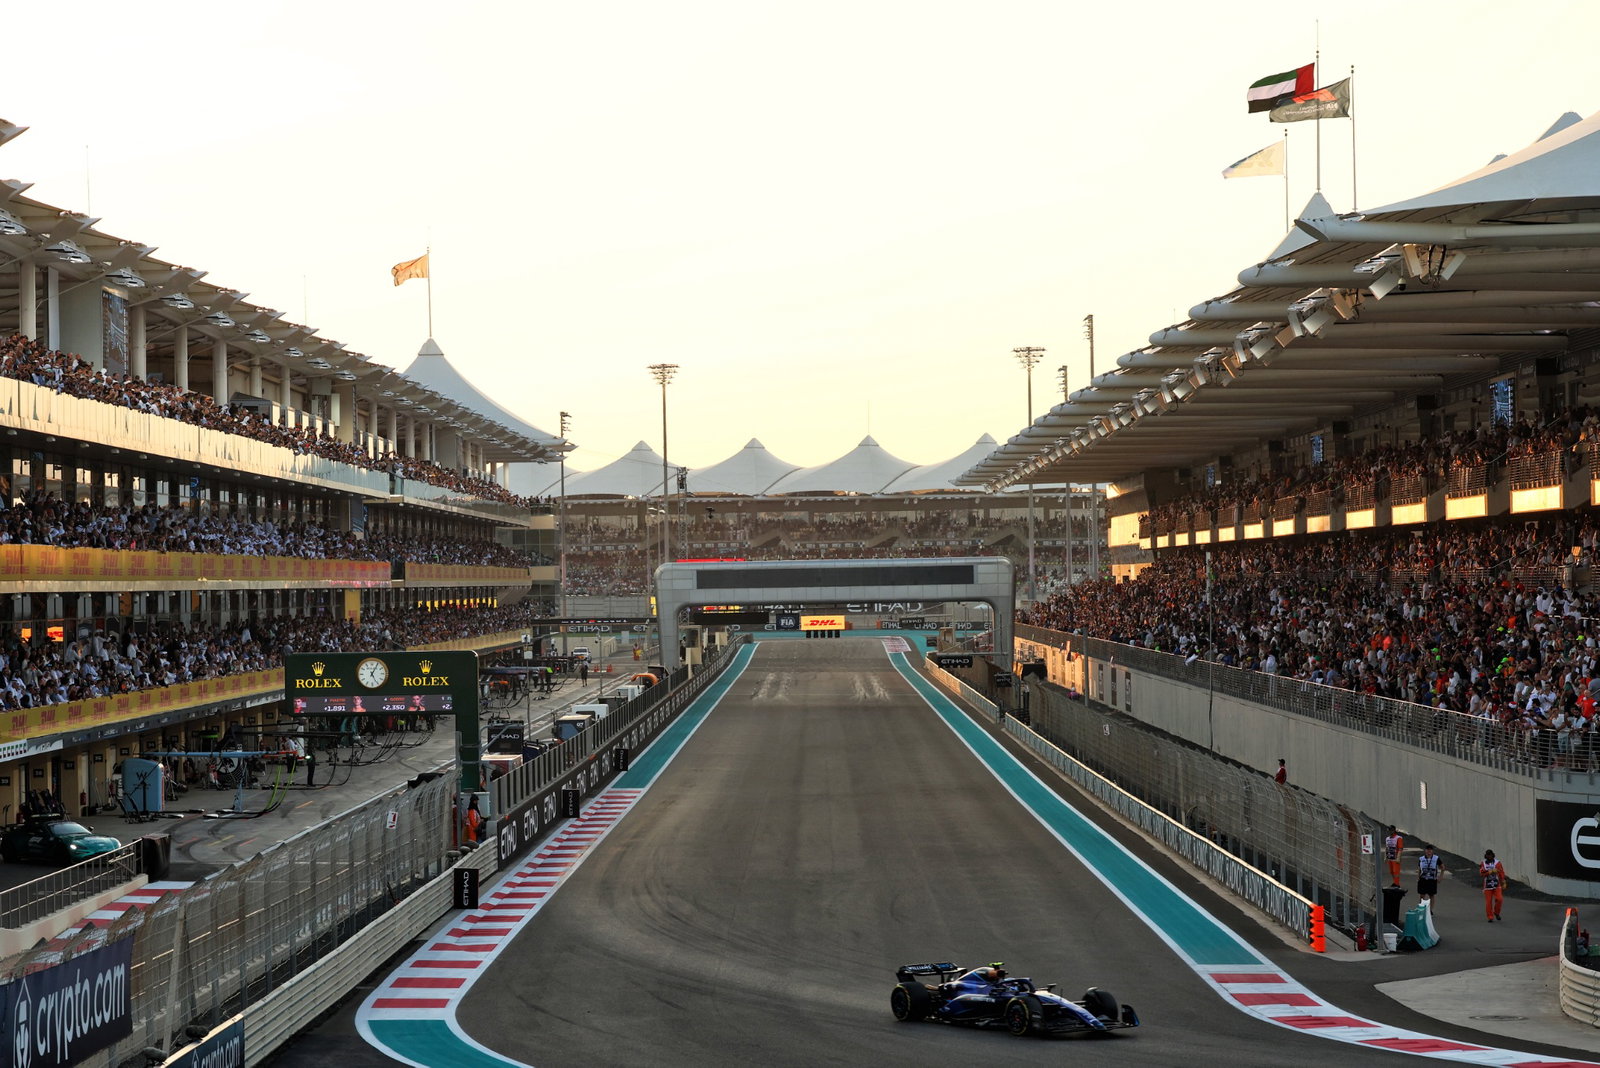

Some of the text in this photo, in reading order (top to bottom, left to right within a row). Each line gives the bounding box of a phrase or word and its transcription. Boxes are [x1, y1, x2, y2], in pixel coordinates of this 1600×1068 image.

[780, 618, 794, 626] FIA
[568, 625, 610, 633] ETIHAD
[295, 678, 342, 689] ROLEX
[403, 676, 449, 687] ROLEX
[501, 820, 518, 860] ETIHAD
[462, 871, 470, 906] ETIHAD
[36, 962, 126, 1064] crypto.com
